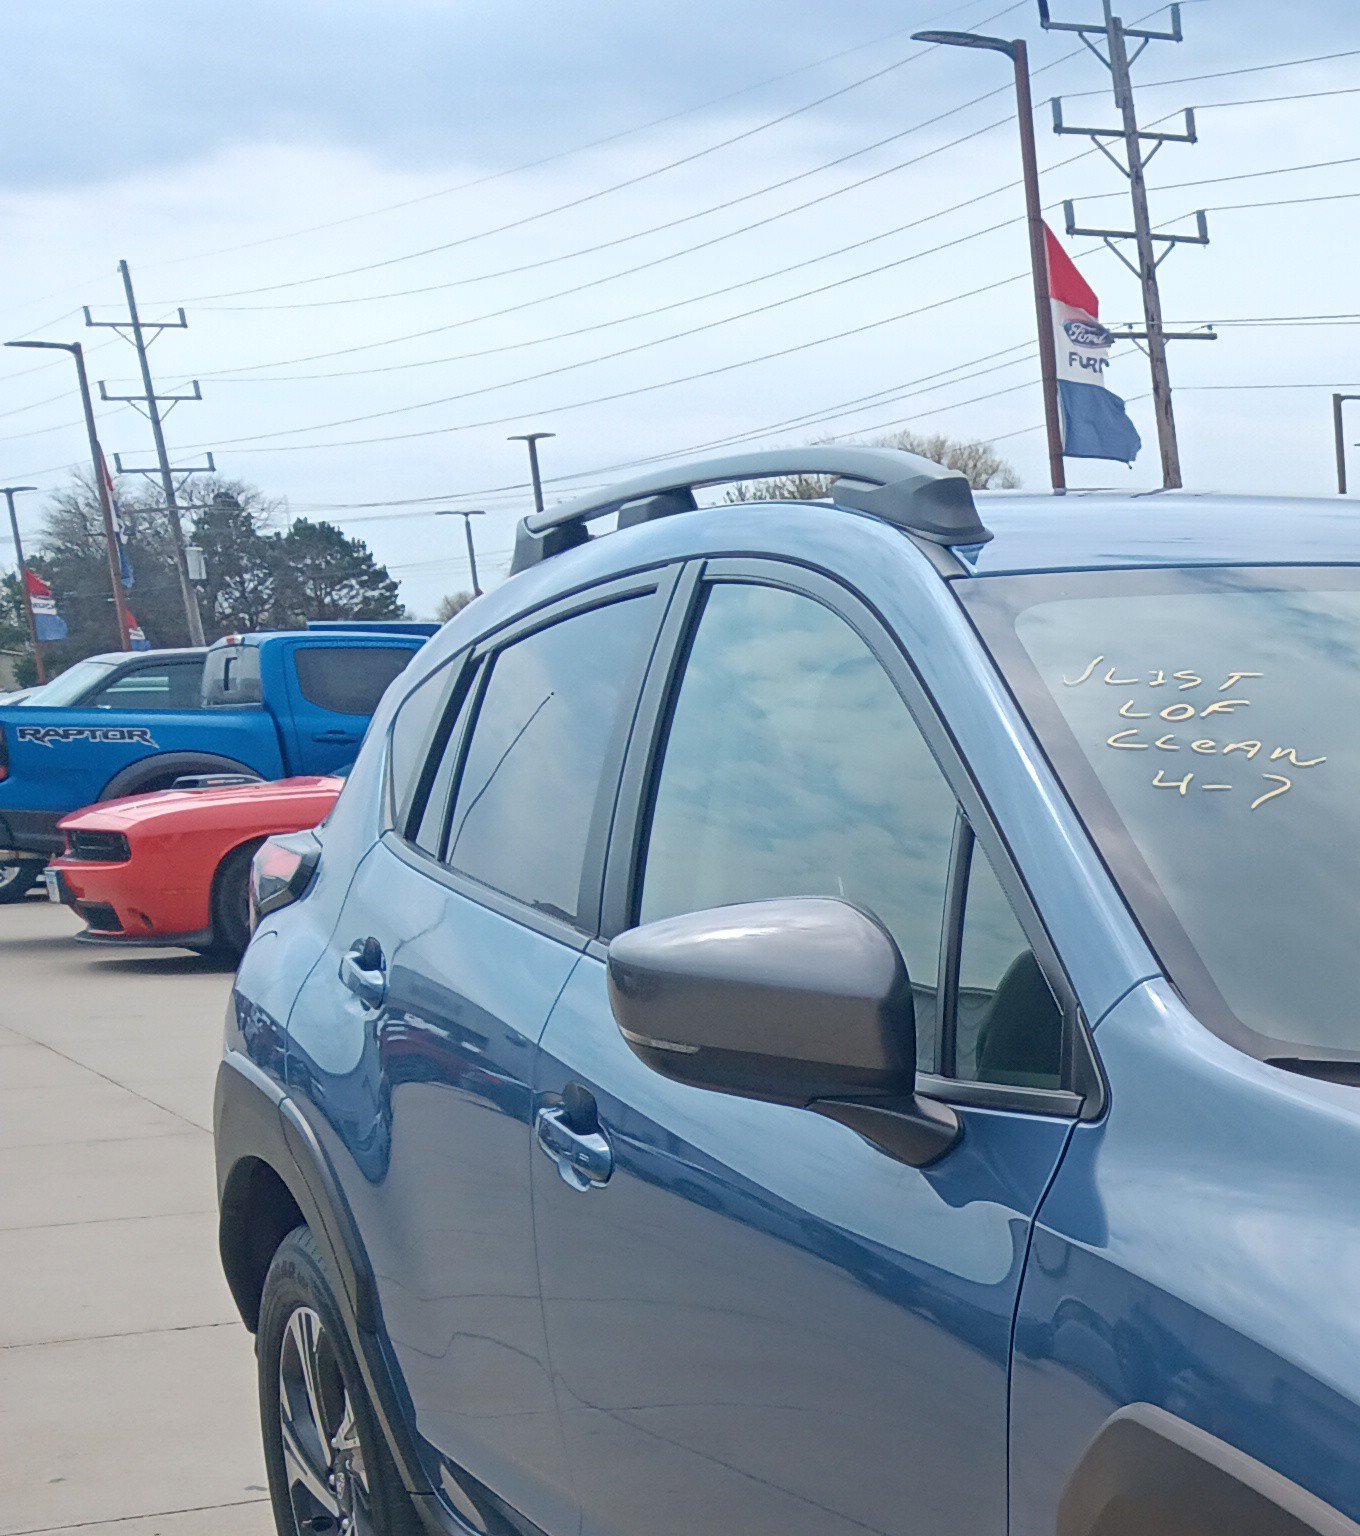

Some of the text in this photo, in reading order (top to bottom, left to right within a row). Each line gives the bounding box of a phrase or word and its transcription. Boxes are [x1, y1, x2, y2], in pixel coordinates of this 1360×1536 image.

[1069, 322, 1108, 344] Ford
[1119, 699, 1250, 722] LOF
[17, 727, 160, 749] RAPTOR
